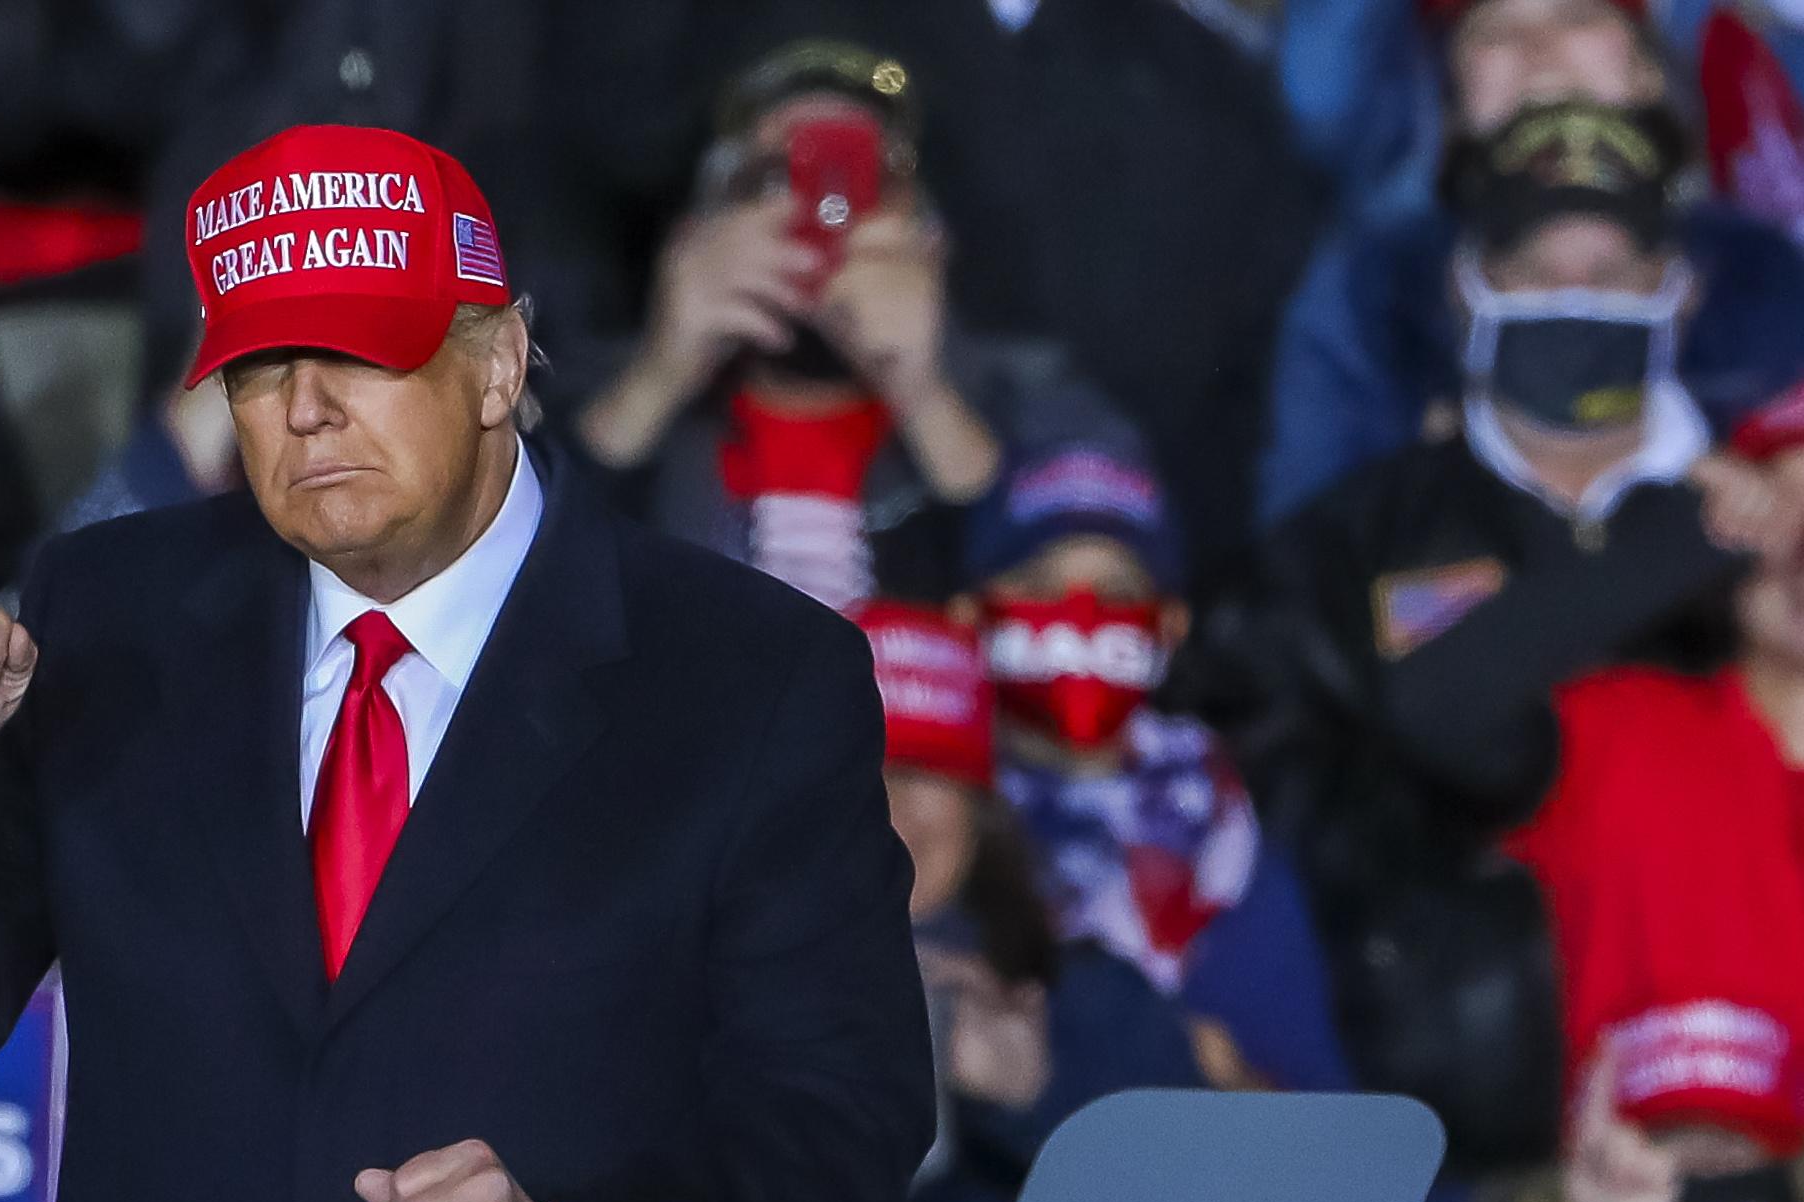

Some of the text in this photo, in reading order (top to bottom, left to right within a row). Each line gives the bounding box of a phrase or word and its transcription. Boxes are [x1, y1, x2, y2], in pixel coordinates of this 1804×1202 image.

[195, 171, 425, 246] MAKE AMERICA
[212, 227, 409, 296] GREAT AGAIN
